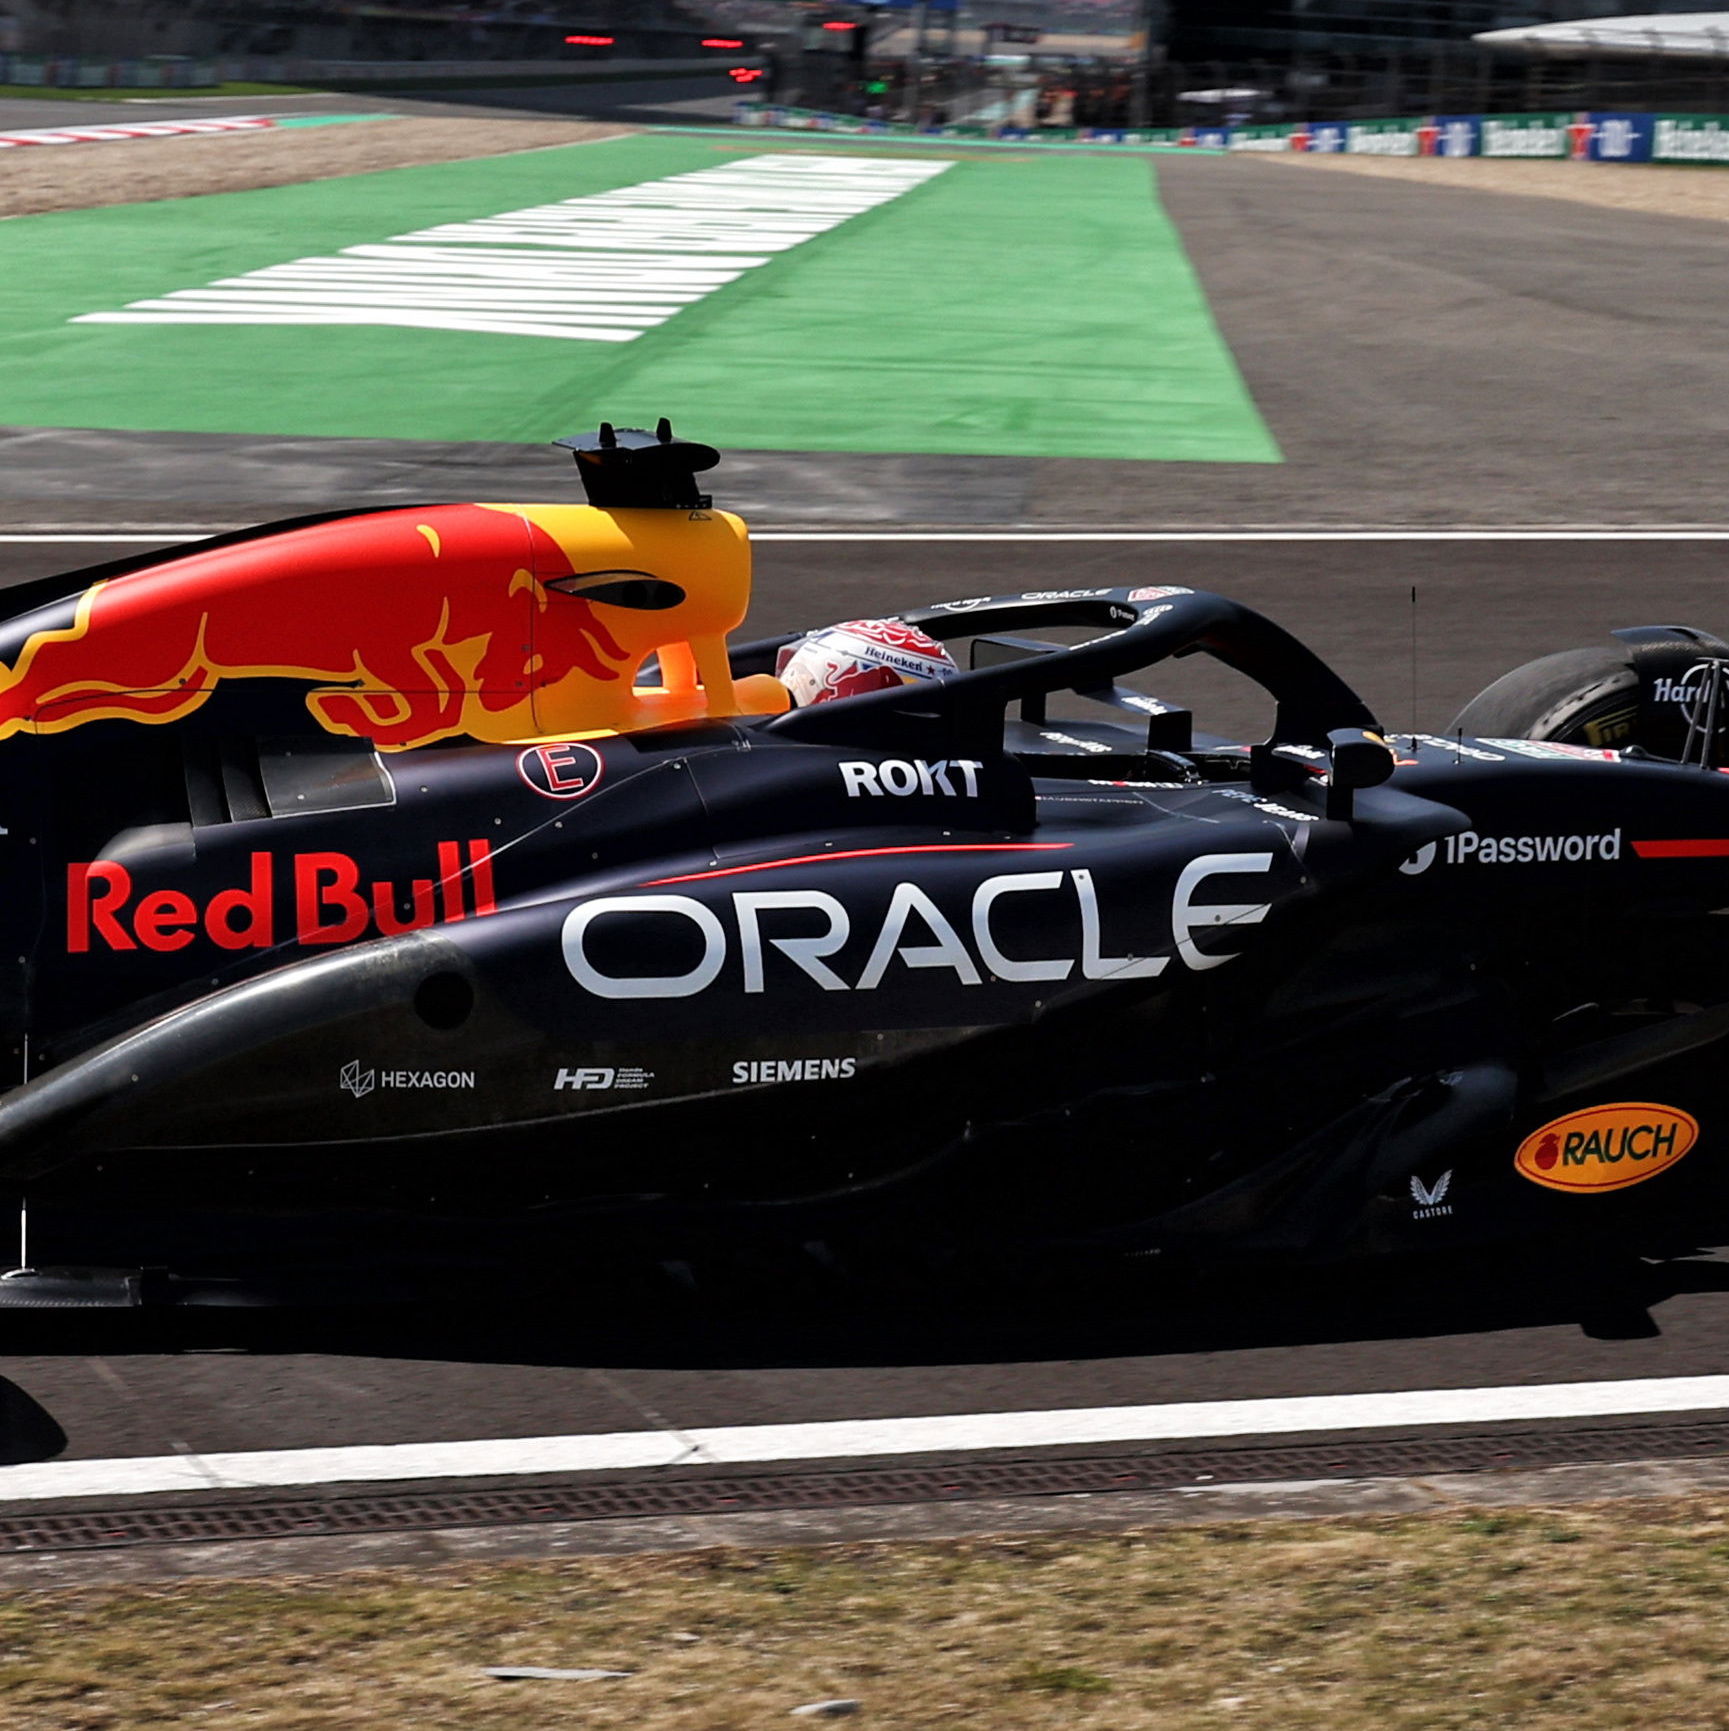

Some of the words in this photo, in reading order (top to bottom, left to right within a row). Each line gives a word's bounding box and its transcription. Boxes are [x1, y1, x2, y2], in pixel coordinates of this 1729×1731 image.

[70, 245, 769, 342] DRINK
[1021, 588, 1113, 600] ORACLE
[865, 646, 923, 671] Heineken
[1654, 678, 1711, 703] Hard
[838, 758, 984, 799] ROKT
[1445, 828, 1621, 865] 1Password
[68, 852, 273, 954] Red
[294, 839, 497, 946] Bull
[562, 852, 1274, 998] ORACLE
[381, 1070, 475, 1091] HEXAGON
[732, 1057, 856, 1085] SIEMENS
[1562, 1122, 1678, 1166] RAUCH
